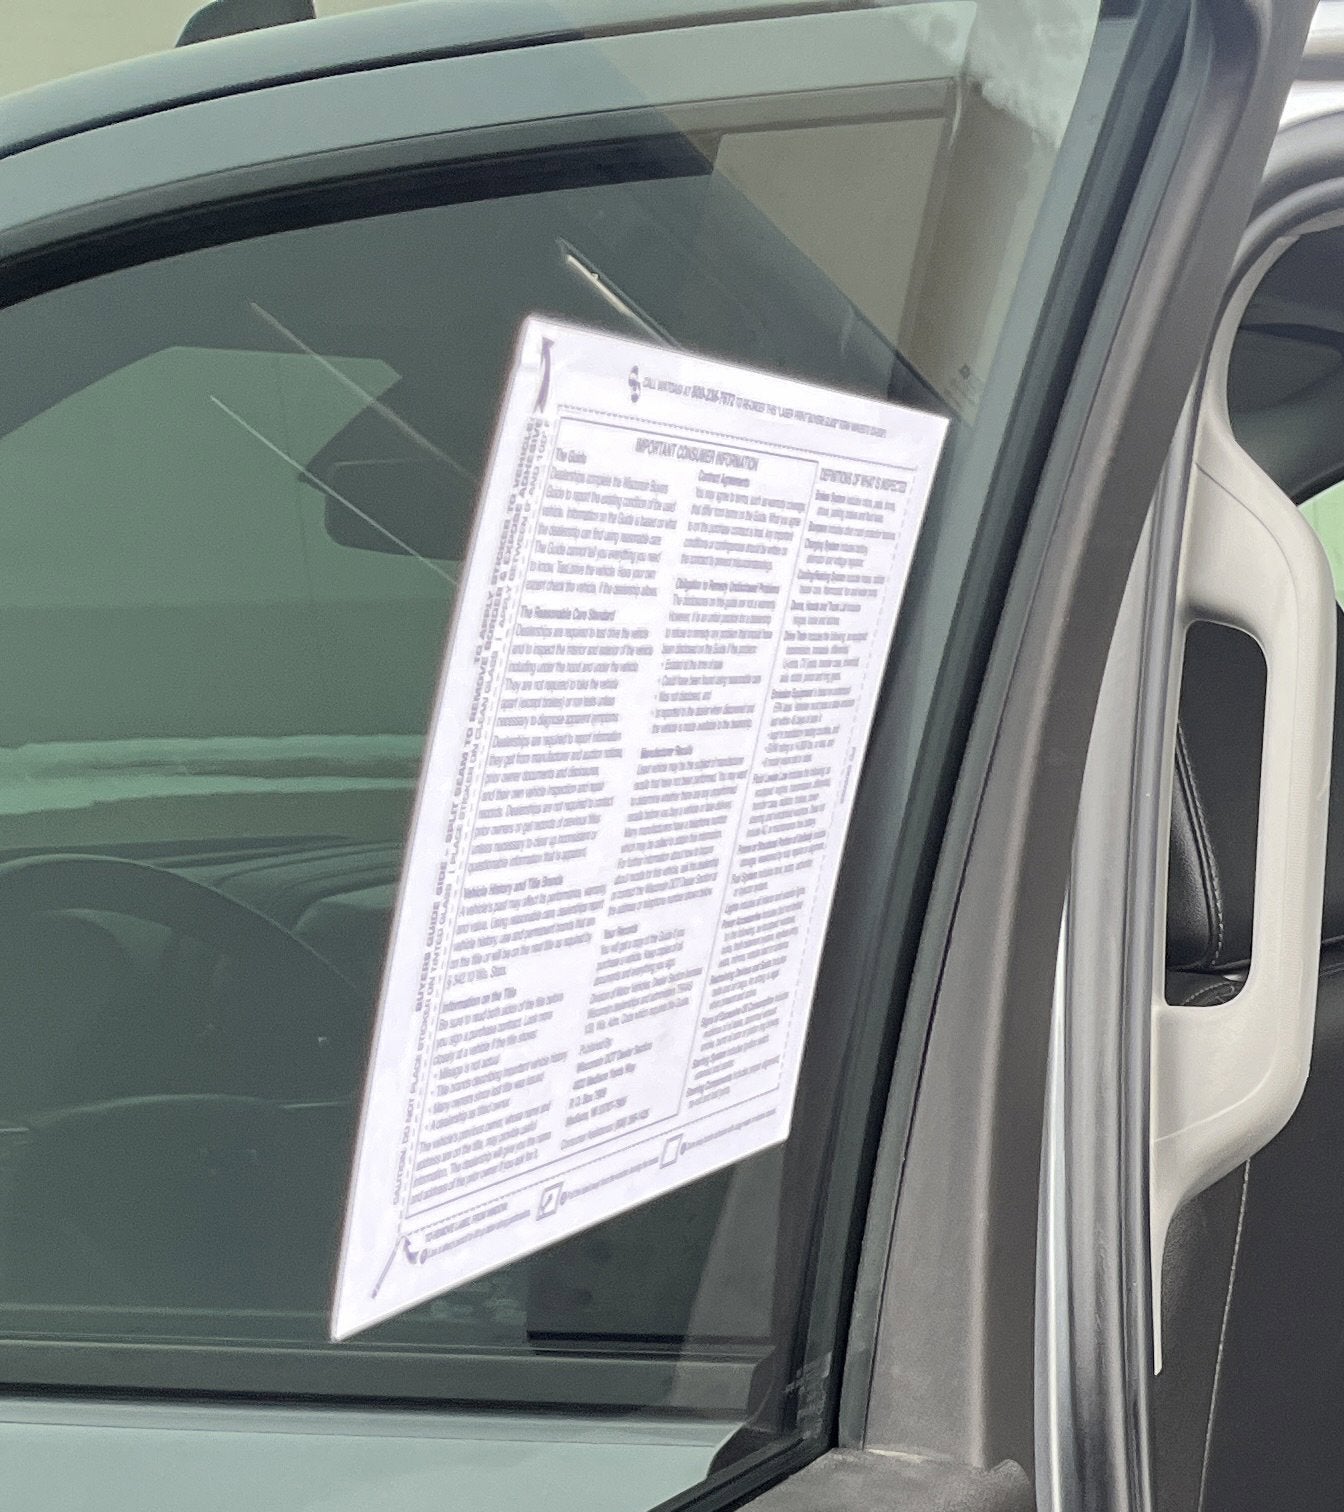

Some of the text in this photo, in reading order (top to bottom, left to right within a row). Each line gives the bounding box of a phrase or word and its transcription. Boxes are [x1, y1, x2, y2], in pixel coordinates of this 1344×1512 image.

[635, 438, 758, 470] IMPORTANT CONSUMER INFORMATION
[473, 644, 483, 663] TO
[479, 591, 493, 638] APPLY
[491, 519, 510, 584] STICKER
[506, 493, 516, 512] TO
[426, 901, 439, 946] GUIDE
[436, 861, 447, 895] SIDE
[445, 802, 458, 843] SPLIT
[454, 752, 468, 796] SEAM
[464, 727, 473, 747] TO
[469, 657, 488, 721] REMOVE
[484, 587, 502, 650] BORDER
[503, 504, 521, 565] EXPOSE
[519, 419, 542, 497] ADHESIVE
